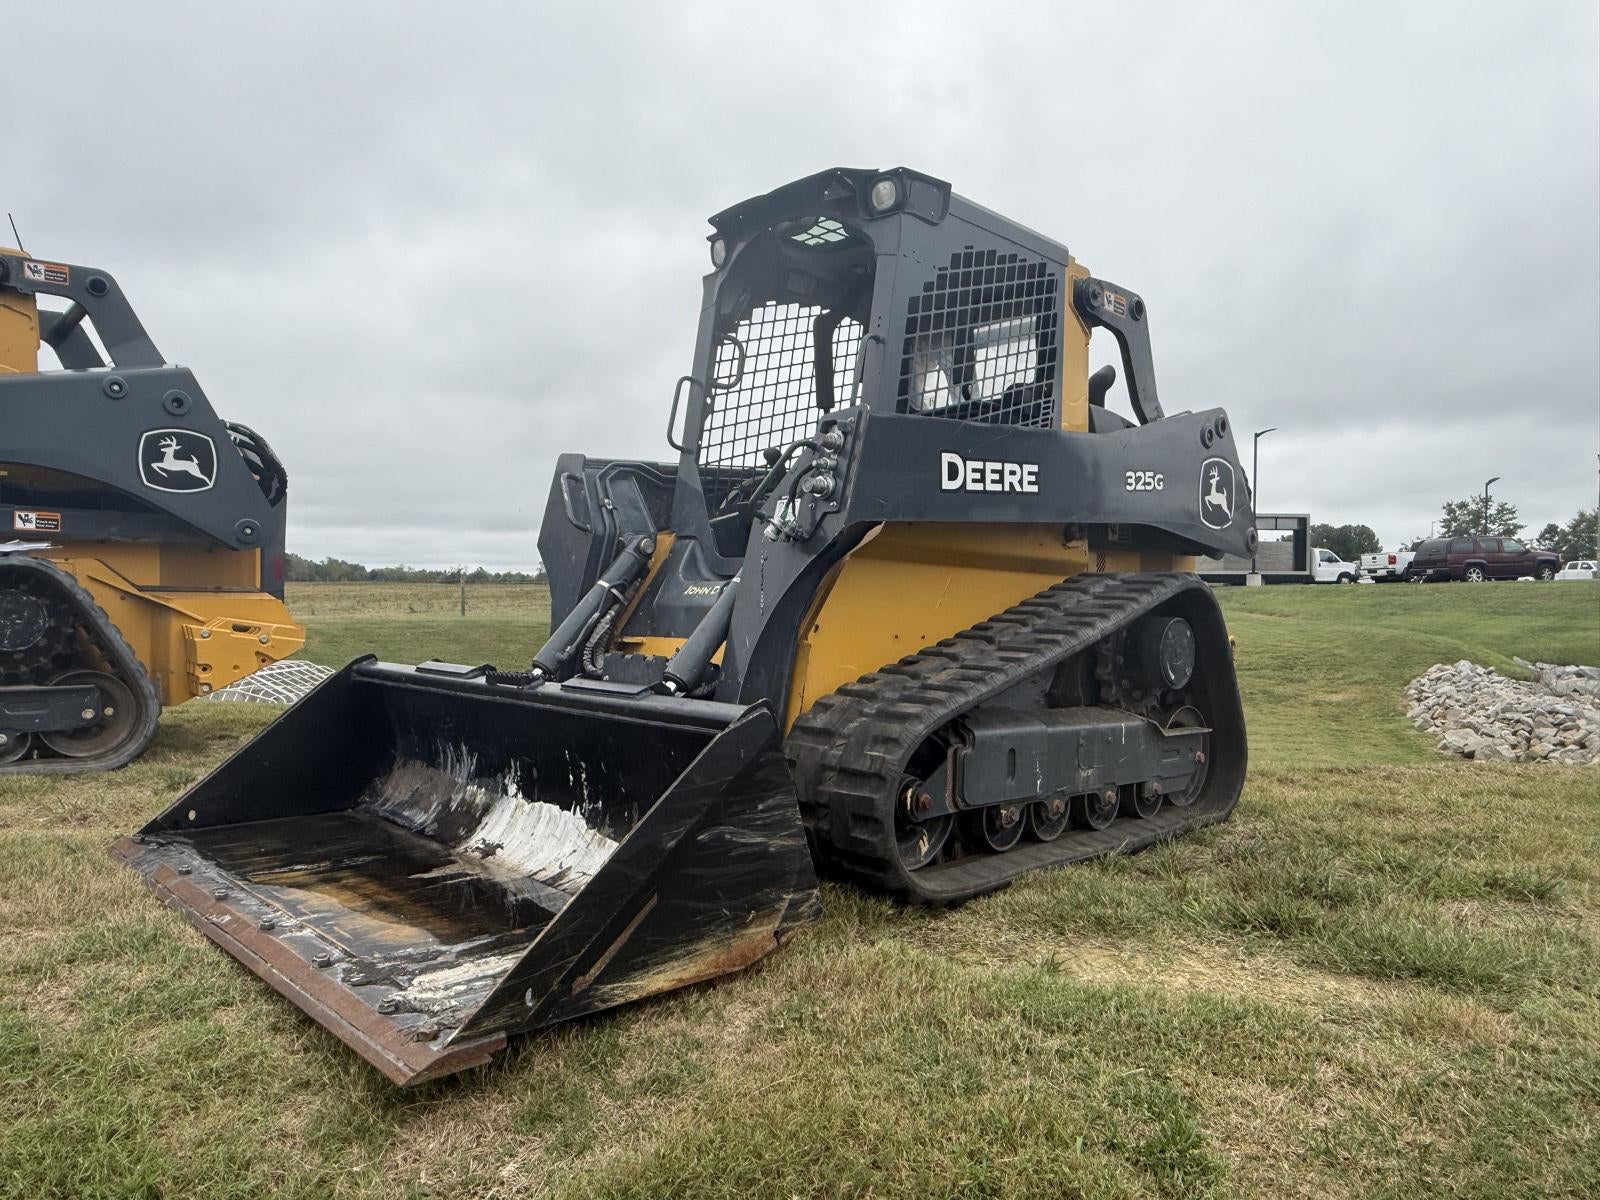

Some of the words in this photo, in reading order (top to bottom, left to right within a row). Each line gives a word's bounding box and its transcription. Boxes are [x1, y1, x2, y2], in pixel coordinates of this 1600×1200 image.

[941, 452, 1039, 493] DEERE
[1125, 471, 1164, 491] 325G
[684, 585, 711, 595] JOHN
